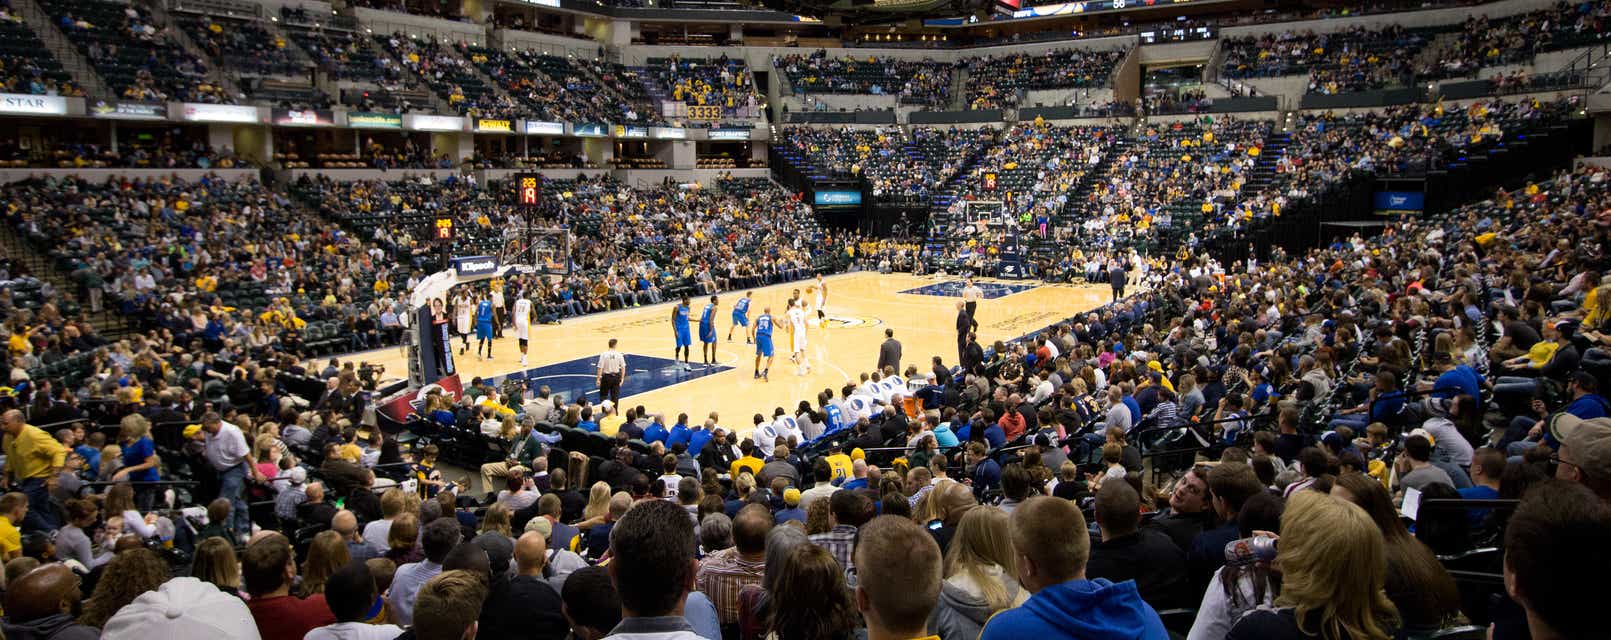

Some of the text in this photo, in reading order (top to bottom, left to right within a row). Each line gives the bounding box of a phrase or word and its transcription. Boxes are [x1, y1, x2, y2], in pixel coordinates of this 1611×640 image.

[6, 98, 44, 108] STAR
[689, 106, 720, 119] 3333
[525, 188, 536, 204] 19
[461, 260, 495, 272] Klipsch
[758, 320, 769, 330] 24
